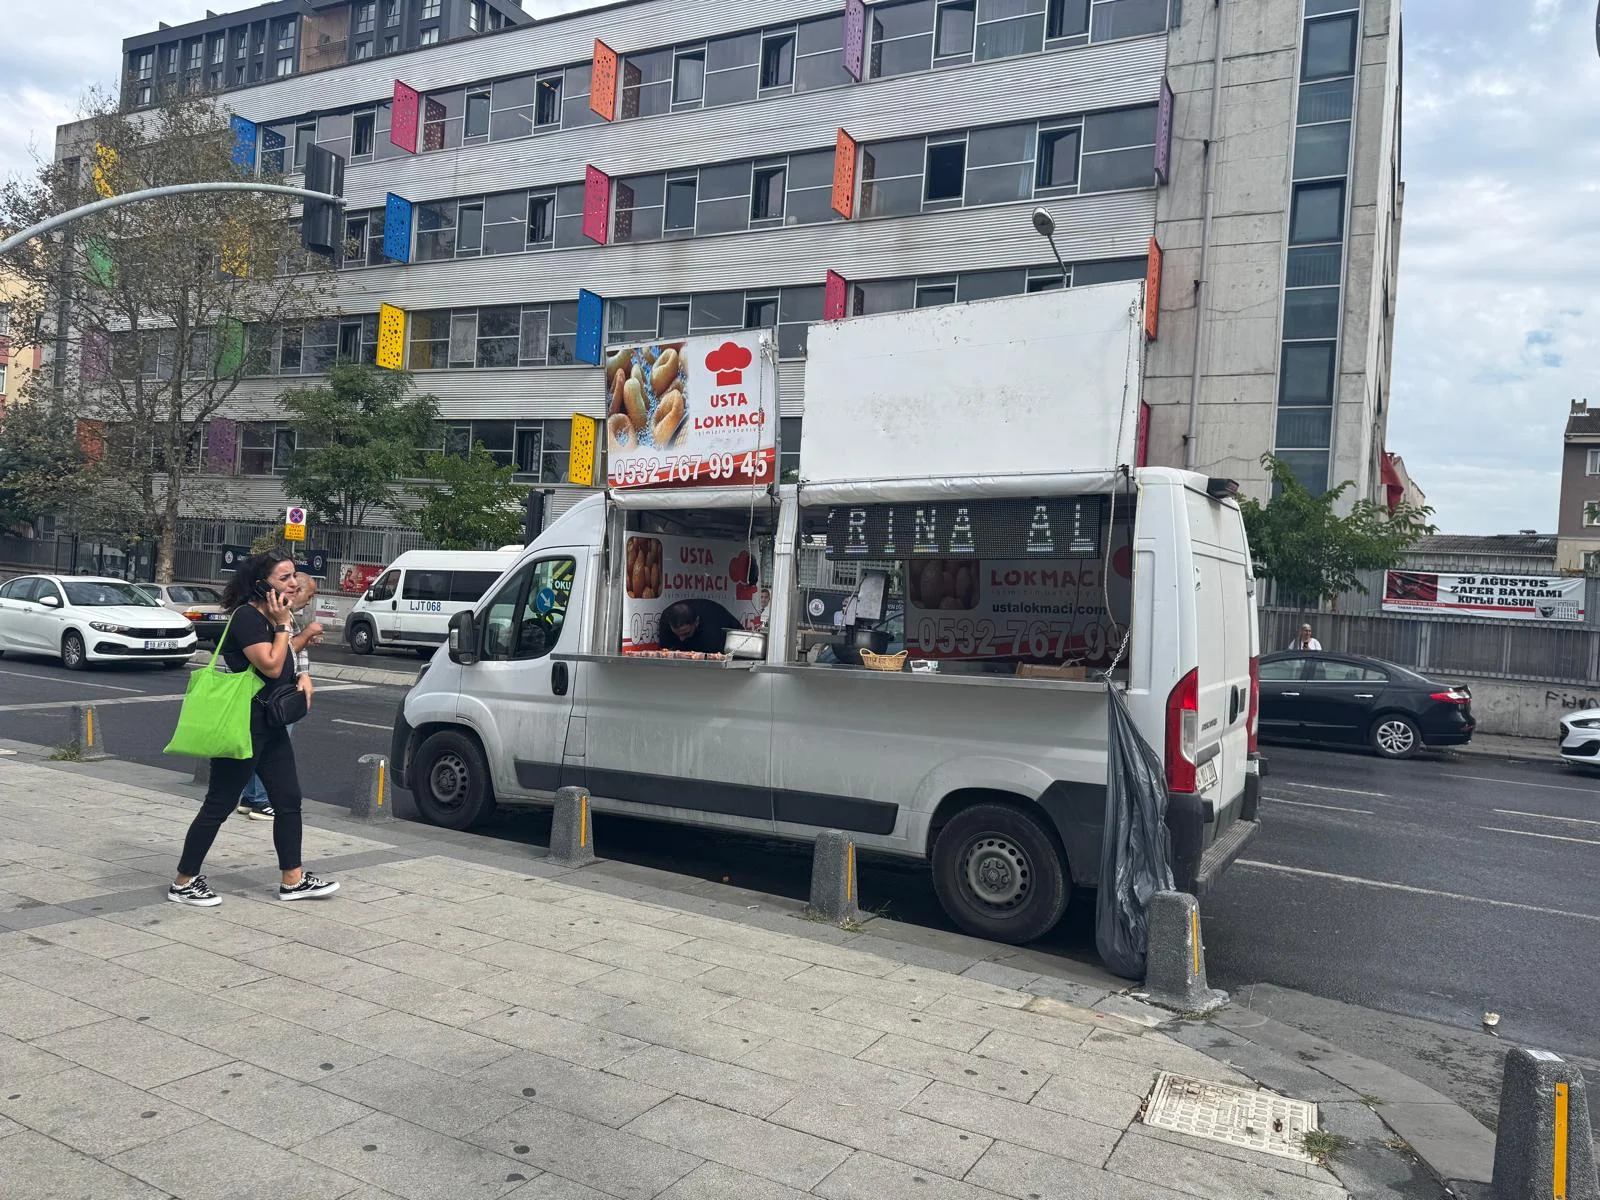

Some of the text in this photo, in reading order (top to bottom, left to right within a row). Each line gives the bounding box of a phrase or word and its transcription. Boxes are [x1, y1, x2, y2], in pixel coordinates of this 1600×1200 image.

[710, 393, 748, 408] USTA
[694, 411, 765, 430] LOKMACI
[614, 451, 768, 485] 0532 767 99 45
[825, 508, 975, 554] RINA
[680, 546, 714, 566] USTA
[664, 573, 729, 592] LOKMACI
[990, 569, 1105, 588] LOKMACI
[1457, 575, 1549, 588] 30 AĞUSTOS
[1450, 585, 1563, 598] ZAFER BAYRAMI
[1457, 595, 1495, 606] KUTLU
[1497, 597, 1534, 607] OLSUN
[992, 602, 1109, 615] ustalokmaci.com
[917, 616, 1129, 662] 0532 767 99
